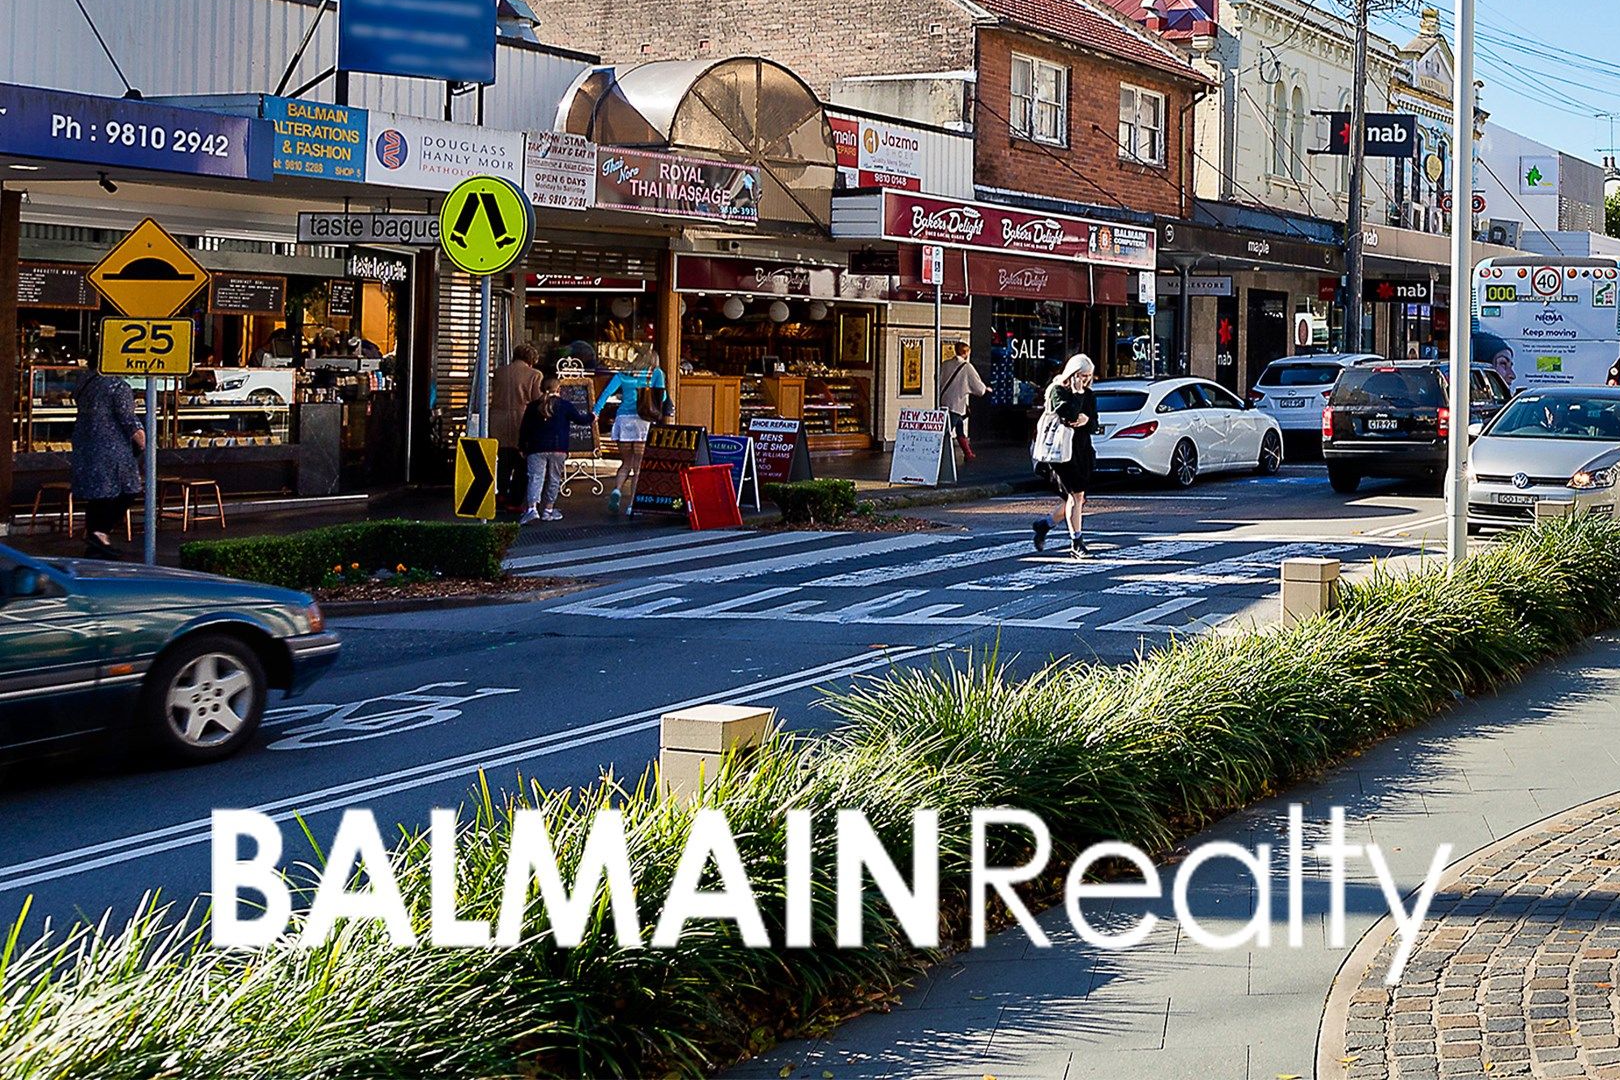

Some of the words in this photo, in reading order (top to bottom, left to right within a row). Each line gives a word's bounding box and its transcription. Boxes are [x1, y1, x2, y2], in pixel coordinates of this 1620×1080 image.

[287, 102, 349, 124] BALMAIN
[52, 114, 81, 141] Ph
[105, 122, 166, 150] 9810
[173, 130, 229, 157] 2942
[273, 120, 360, 144] ALTERATIONS
[1367, 123, 1407, 144] nab
[423, 136, 506, 157] DOUGLASS
[528, 142, 542, 152] TAK
[550, 146, 566, 155] WAY
[564, 136, 586, 148] STAR
[882, 131, 918, 151] Jazma
[282, 140, 293, 154] &
[296, 141, 351, 161] FASHION
[836, 145, 857, 157] EPAIRS
[423, 151, 471, 165] HANLY
[478, 158, 514, 170] MOIR
[422, 164, 489, 176] PATHOLO
[660, 163, 705, 184] ROYAL
[535, 173, 558, 184] OPEN
[566, 176, 587, 187] DAYS
[629, 180, 663, 196] THAI
[666, 185, 731, 207] MASSAGE
[310, 214, 363, 236] taste
[371, 214, 440, 241] bague
[911, 205, 947, 236] Bakers
[948, 212, 984, 241] Delight
[1001, 218, 1032, 247] Bakers
[1033, 224, 1064, 250] Delight
[1089, 232, 1097, 252] 4
[1113, 228, 1147, 241] BALMAIN
[1363, 228, 1378, 247] nab
[1247, 239, 1270, 256] maple
[1167, 281, 1225, 289] MAESTORE
[1537, 274, 1557, 289] 40
[1397, 283, 1427, 298] nab
[1488, 286, 1515, 301] 000
[1535, 313, 1564, 322] NRMA
[121, 324, 174, 354] 25
[1522, 328, 1544, 339] Keep
[1546, 328, 1577, 339] moving
[1010, 338, 1045, 359] SALE
[126, 357, 165, 370] km/h
[1217, 351, 1233, 365] nab
[752, 420, 769, 428] SHOE
[770, 420, 798, 429] REPAIRS
[900, 410, 920, 421] NEW
[922, 411, 945, 423] STAR
[900, 421, 920, 430] TAKE
[922, 423, 943, 431] AWAY
[650, 427, 698, 450] THAI
[759, 433, 784, 442] MENS
[755, 442, 769, 451] OE
[770, 443, 794, 452] SHOP
